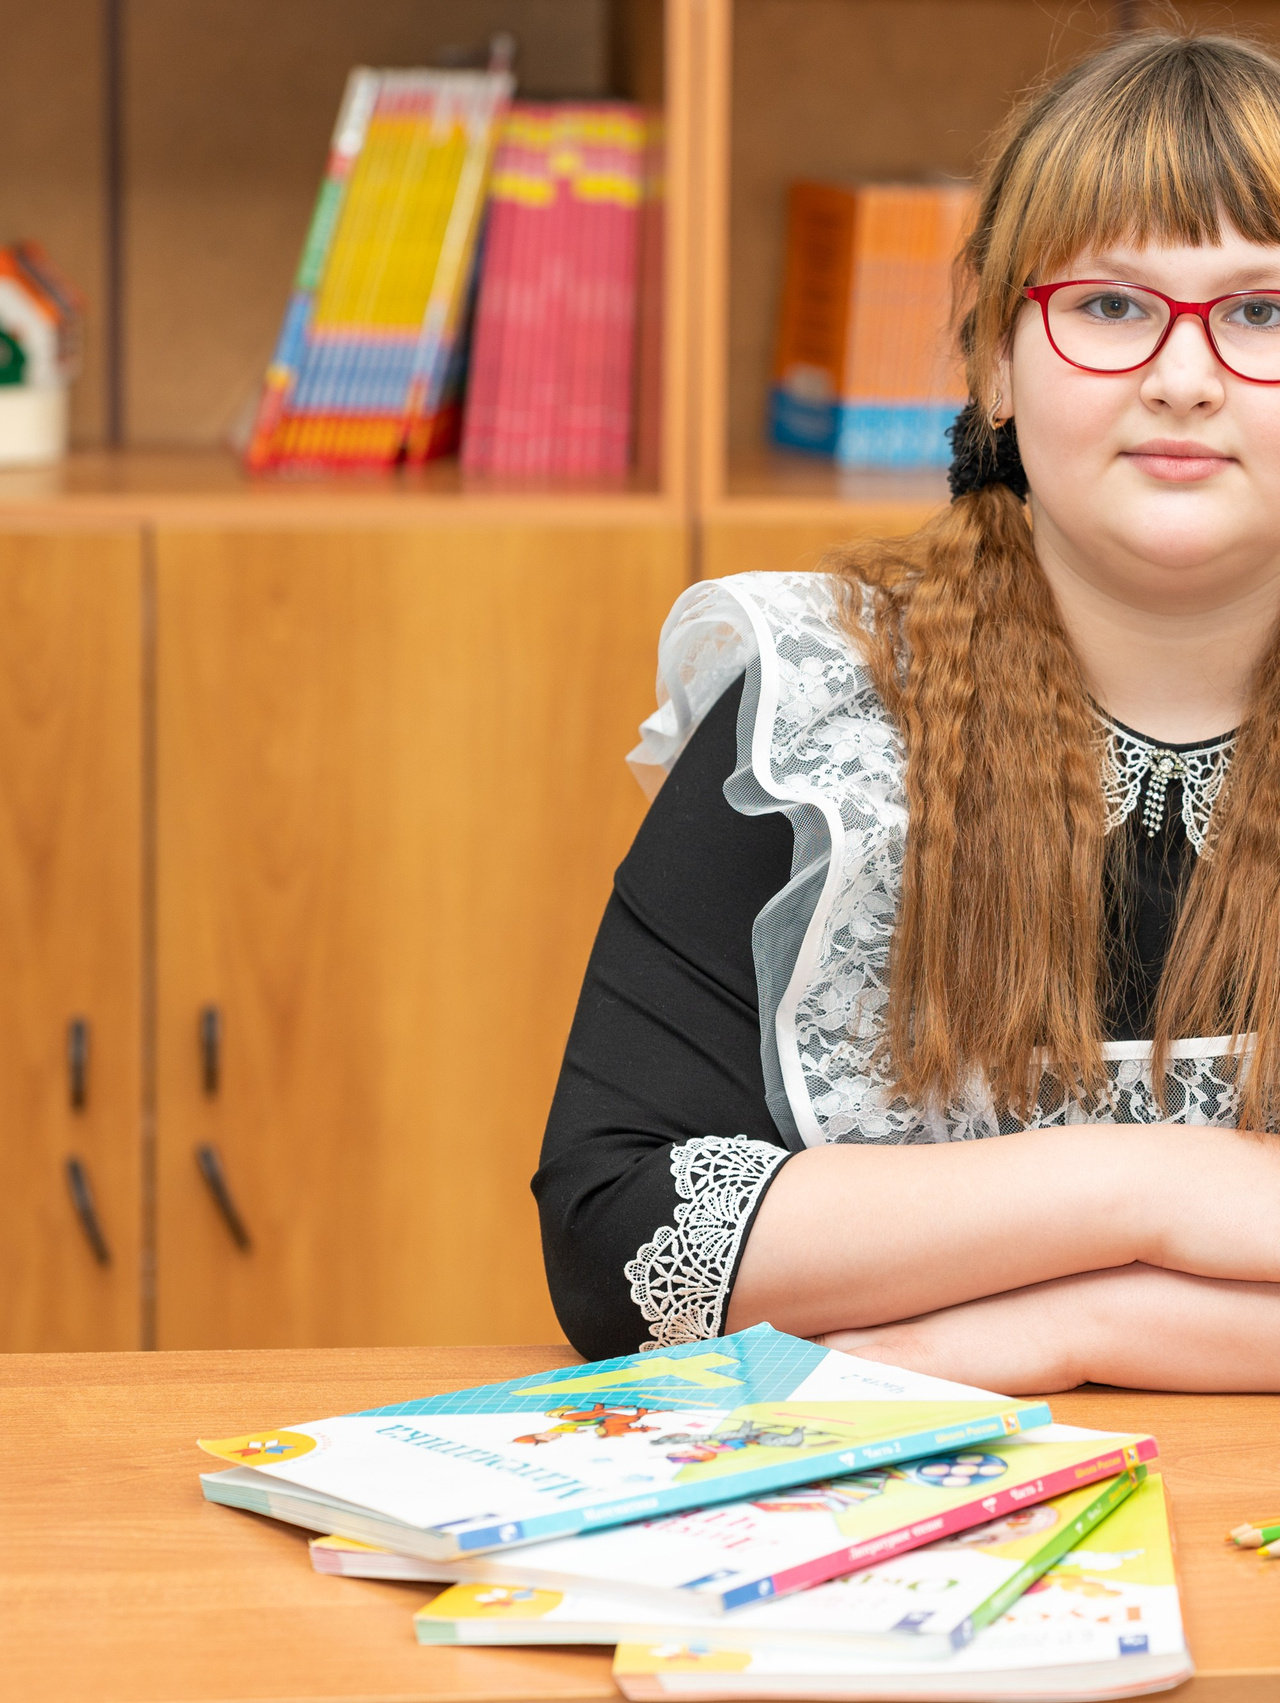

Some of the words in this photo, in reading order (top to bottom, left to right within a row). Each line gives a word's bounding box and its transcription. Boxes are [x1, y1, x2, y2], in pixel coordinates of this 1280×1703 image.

[509, 1352, 747, 1397] 4
[935, 1429, 965, 1444] Школа
[966, 1421, 999, 1437] России
[374, 1423, 592, 1500] Математика
[862, 1444, 892, 1459] Часть
[892, 1441, 901, 1454] 2
[1010, 1484, 1037, 1501] Часть
[1036, 1480, 1044, 1492] 2
